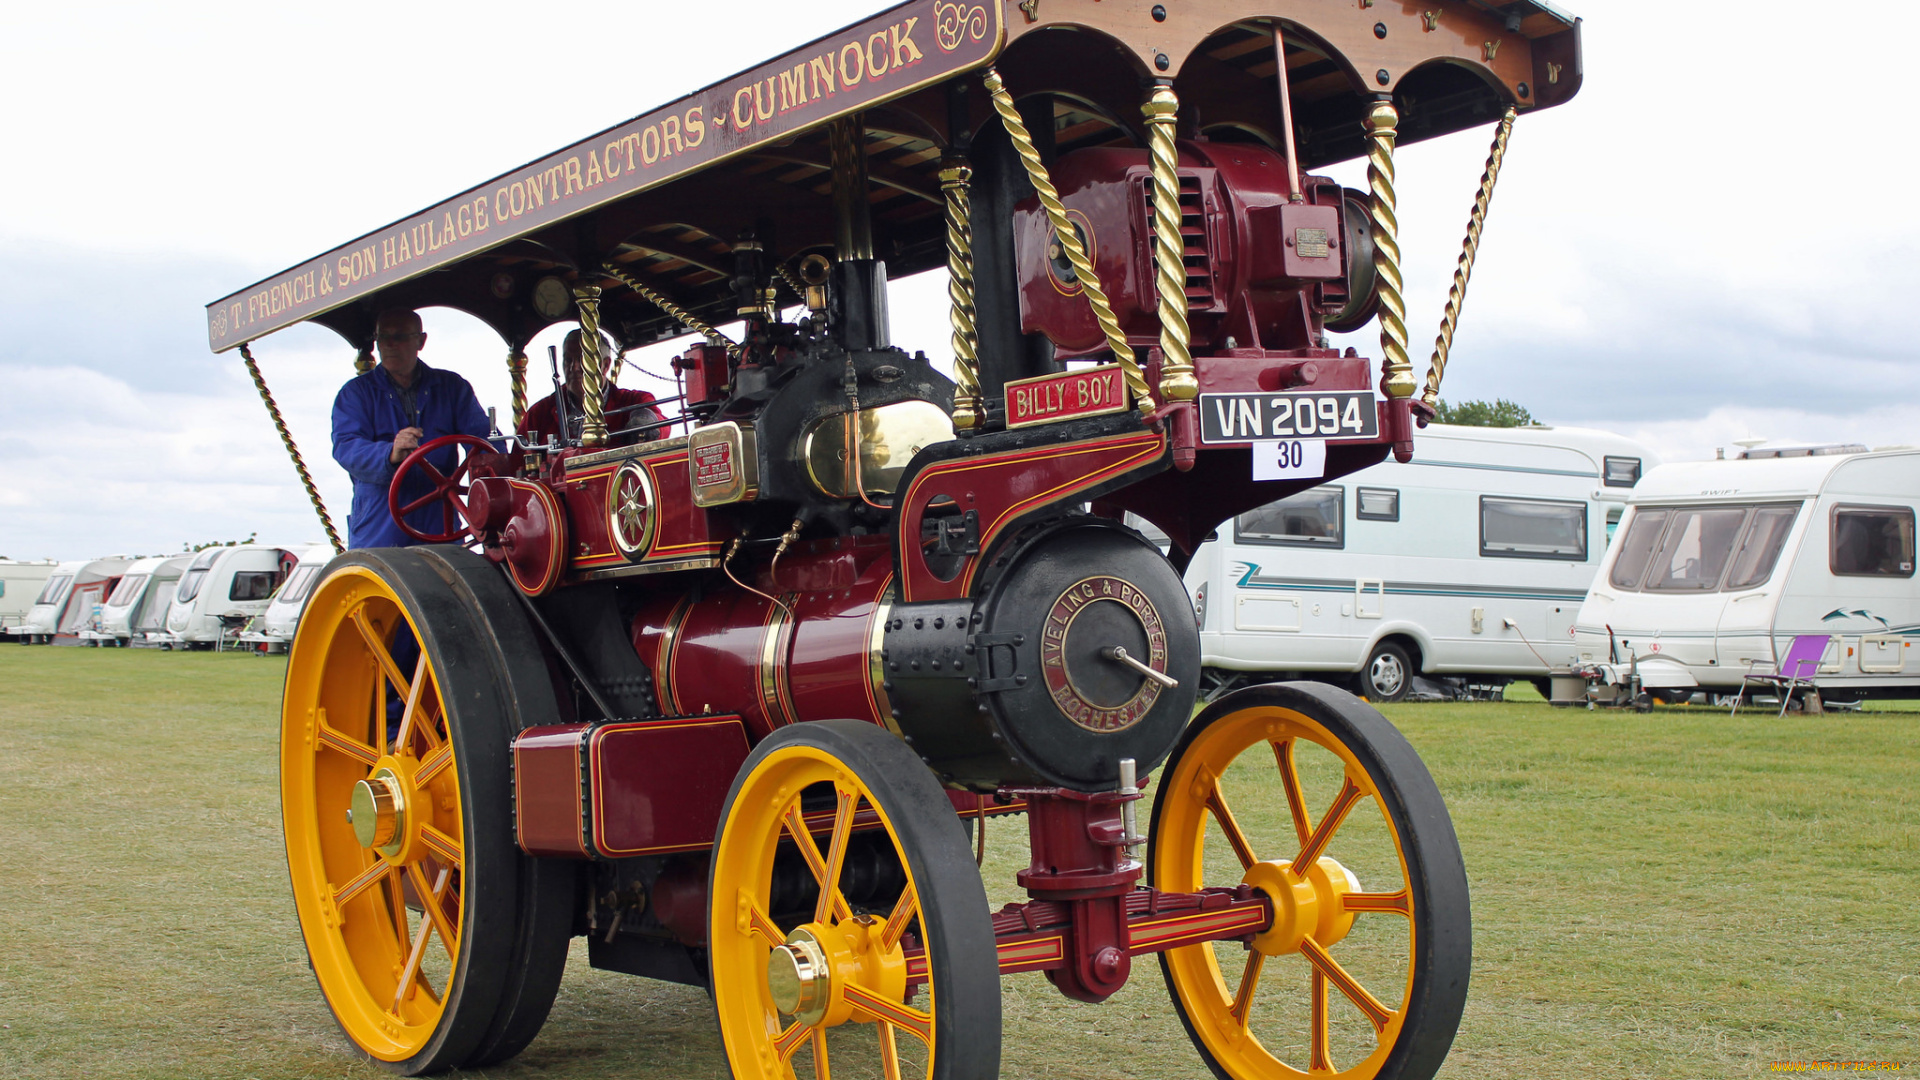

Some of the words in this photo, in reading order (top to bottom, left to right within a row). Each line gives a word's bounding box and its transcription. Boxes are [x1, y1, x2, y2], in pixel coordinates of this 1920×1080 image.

[231, 302, 246, 330] T.
[249, 271, 317, 323] FRENCH
[319, 263, 333, 295] &
[338, 245, 377, 288] SON
[383, 196, 489, 269] HAULAGE
[494, 105, 706, 222] CONTRACTORS
[733, 16, 923, 129] CUMNOCK
[1016, 383, 1065, 418] BILLY
[1077, 374, 1113, 409] BOY
[1216, 397, 1263, 437] VN
[1272, 396, 1364, 436] 2094
[1277, 441, 1302, 469] 30
[1700, 488, 1740, 496] SWIFT
[1044, 583, 1095, 667] AVELING
[1102, 579, 1113, 595] &
[1120, 584, 1165, 662] PORTER
[1054, 678, 1160, 729] ROCHESTER
